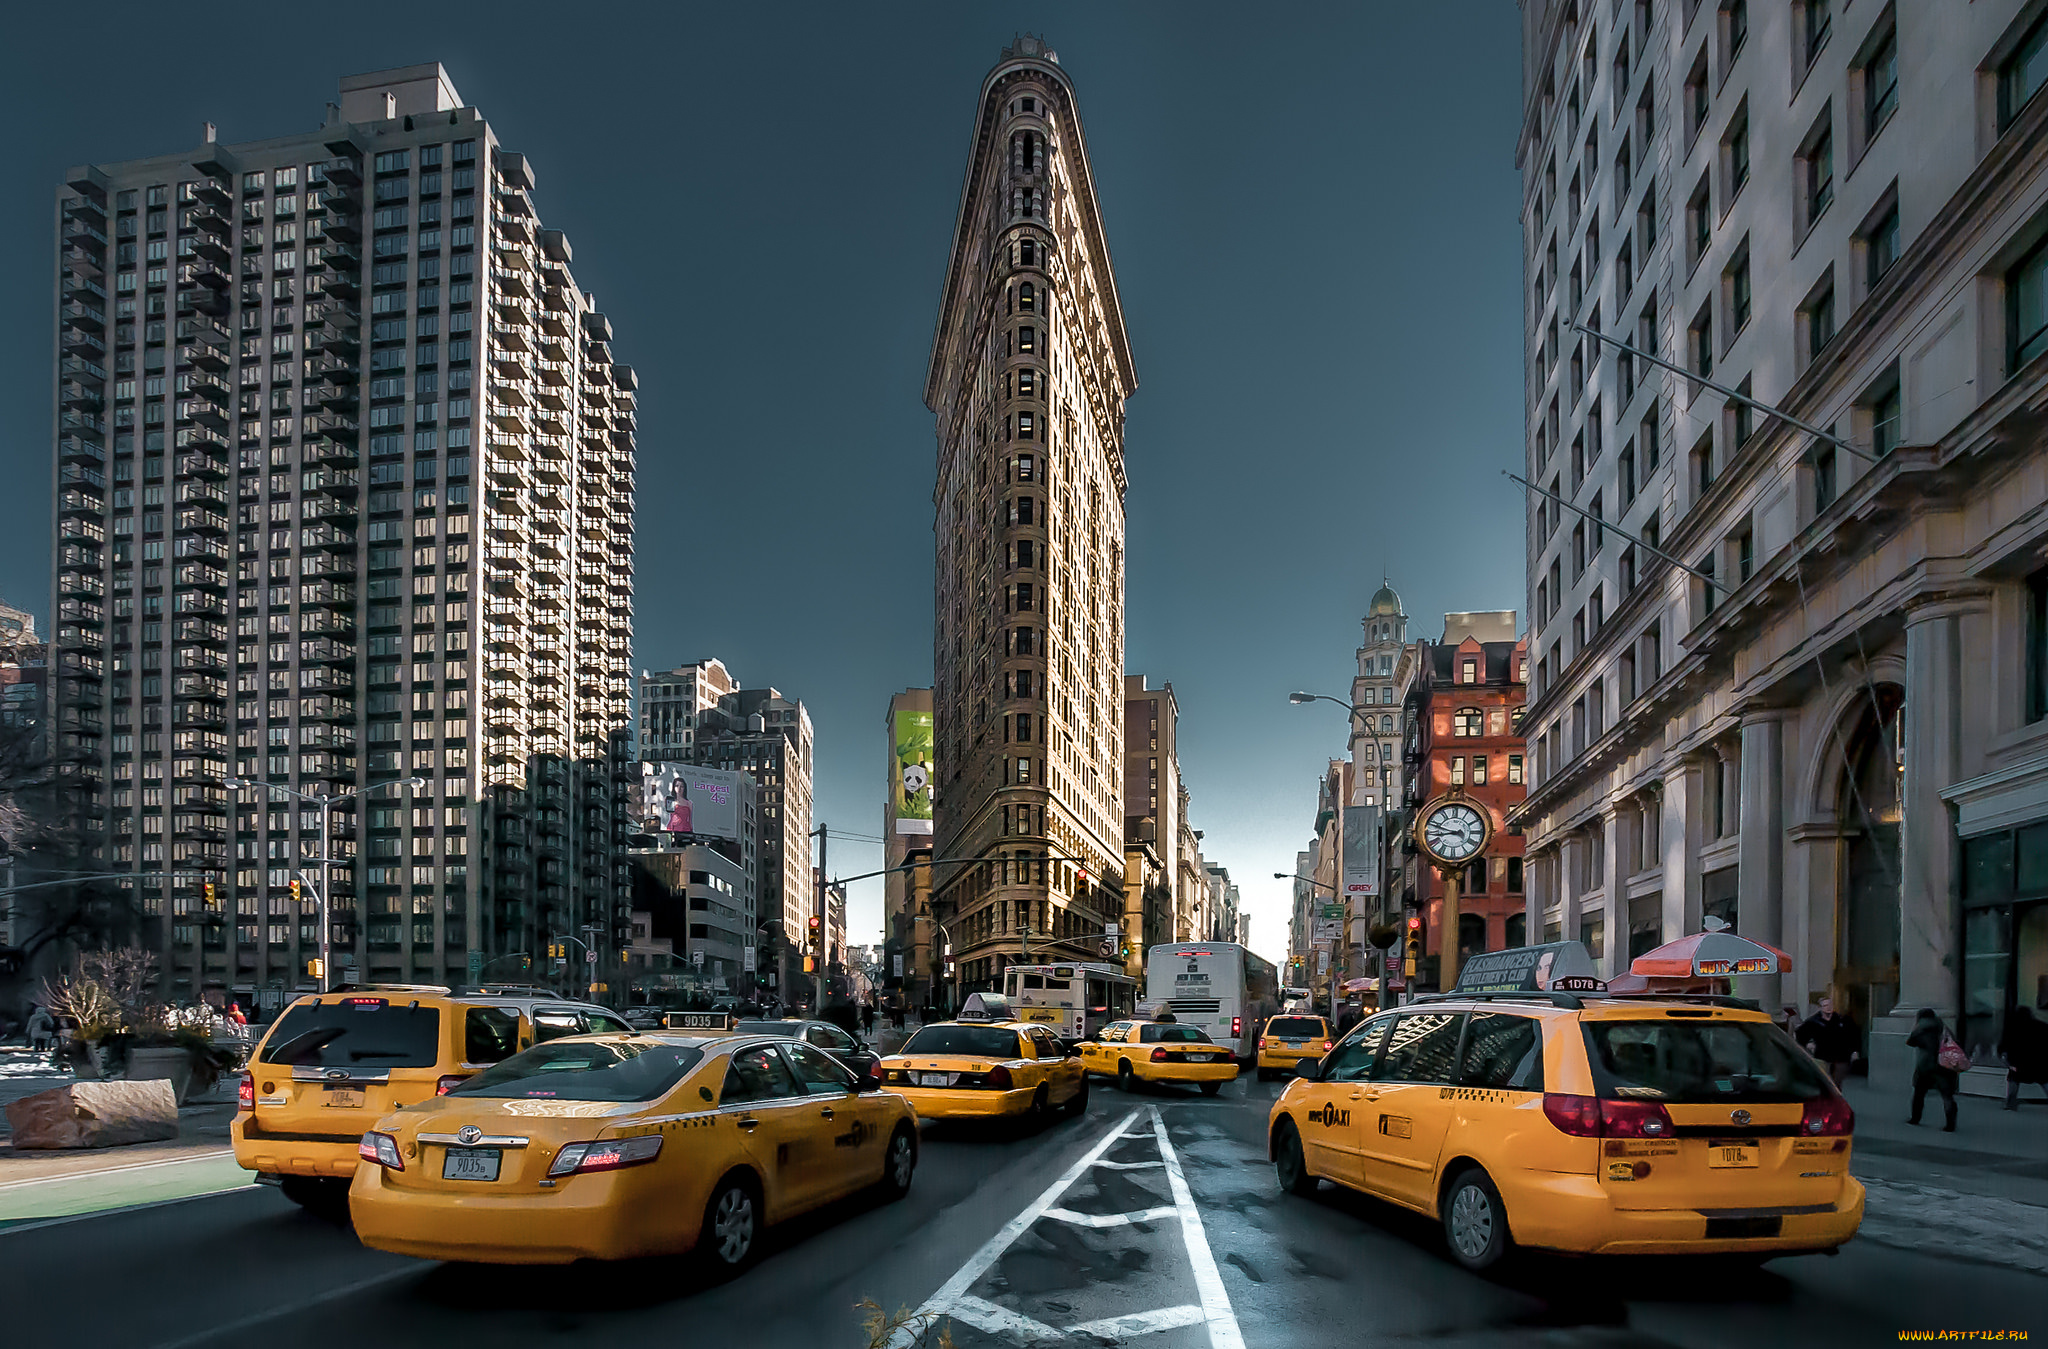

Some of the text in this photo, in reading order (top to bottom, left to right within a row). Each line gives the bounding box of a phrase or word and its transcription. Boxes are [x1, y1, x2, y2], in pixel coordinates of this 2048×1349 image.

[694, 781, 729, 793] Largest
[1347, 884, 1373, 892] GREY
[1464, 951, 1539, 973] FLASHDANCERS
[1462, 968, 1529, 986] GENTLEMEN'S CLUB
[1568, 979, 1594, 989] 1D78
[684, 1015, 711, 1027] 9D35
[1323, 1101, 1350, 1128] TAXI
